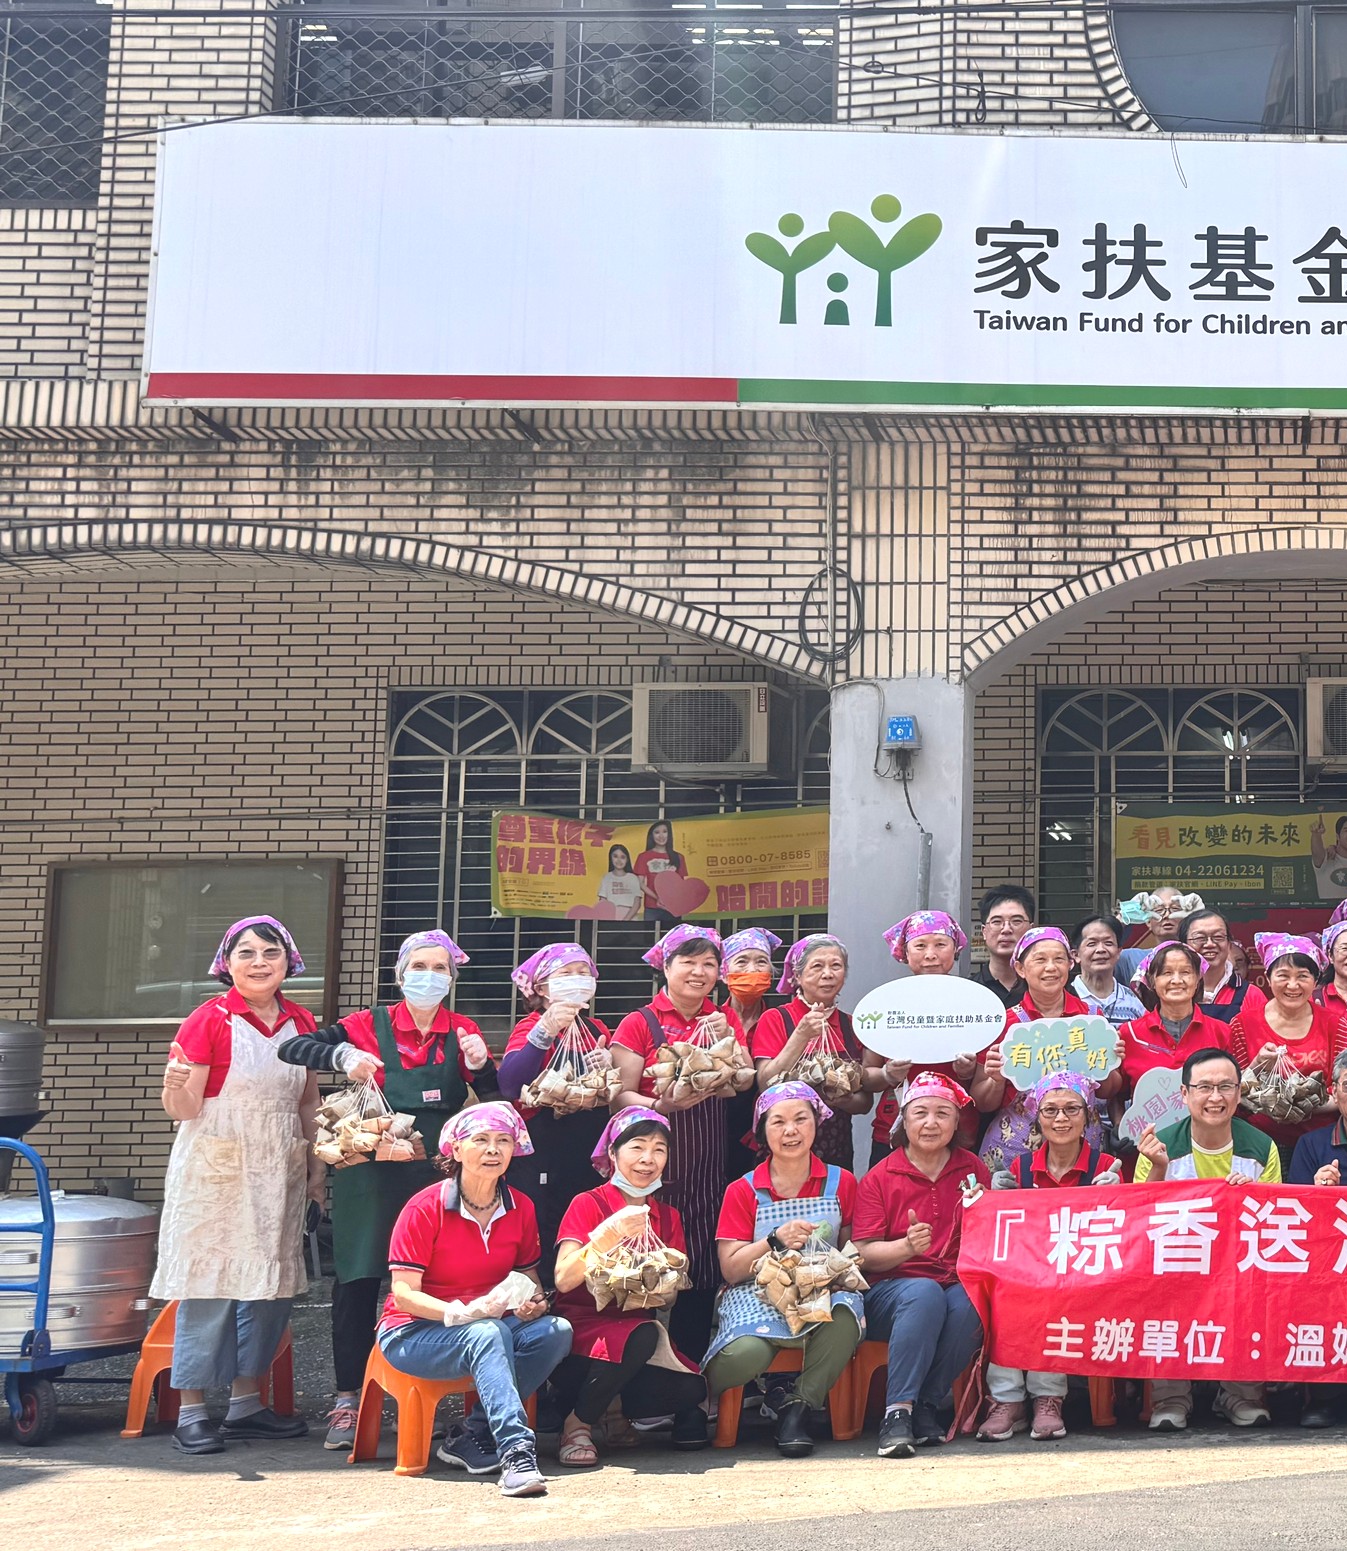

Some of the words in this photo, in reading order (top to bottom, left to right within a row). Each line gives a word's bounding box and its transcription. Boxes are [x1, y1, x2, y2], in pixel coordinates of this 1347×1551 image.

[973, 310, 1068, 331] Taiwan
[1079, 311, 1144, 333] Fund
[1153, 311, 1193, 333] for
[1202, 313, 1311, 335] Children
[1128, 822, 1301, 851] 看見改變的未來
[720, 849, 811, 866] 0800-07-8585
[1175, 864, 1265, 877] 04-22061234
[887, 1014, 1003, 1024] 台灣兒童暨家庭扶助基金會
